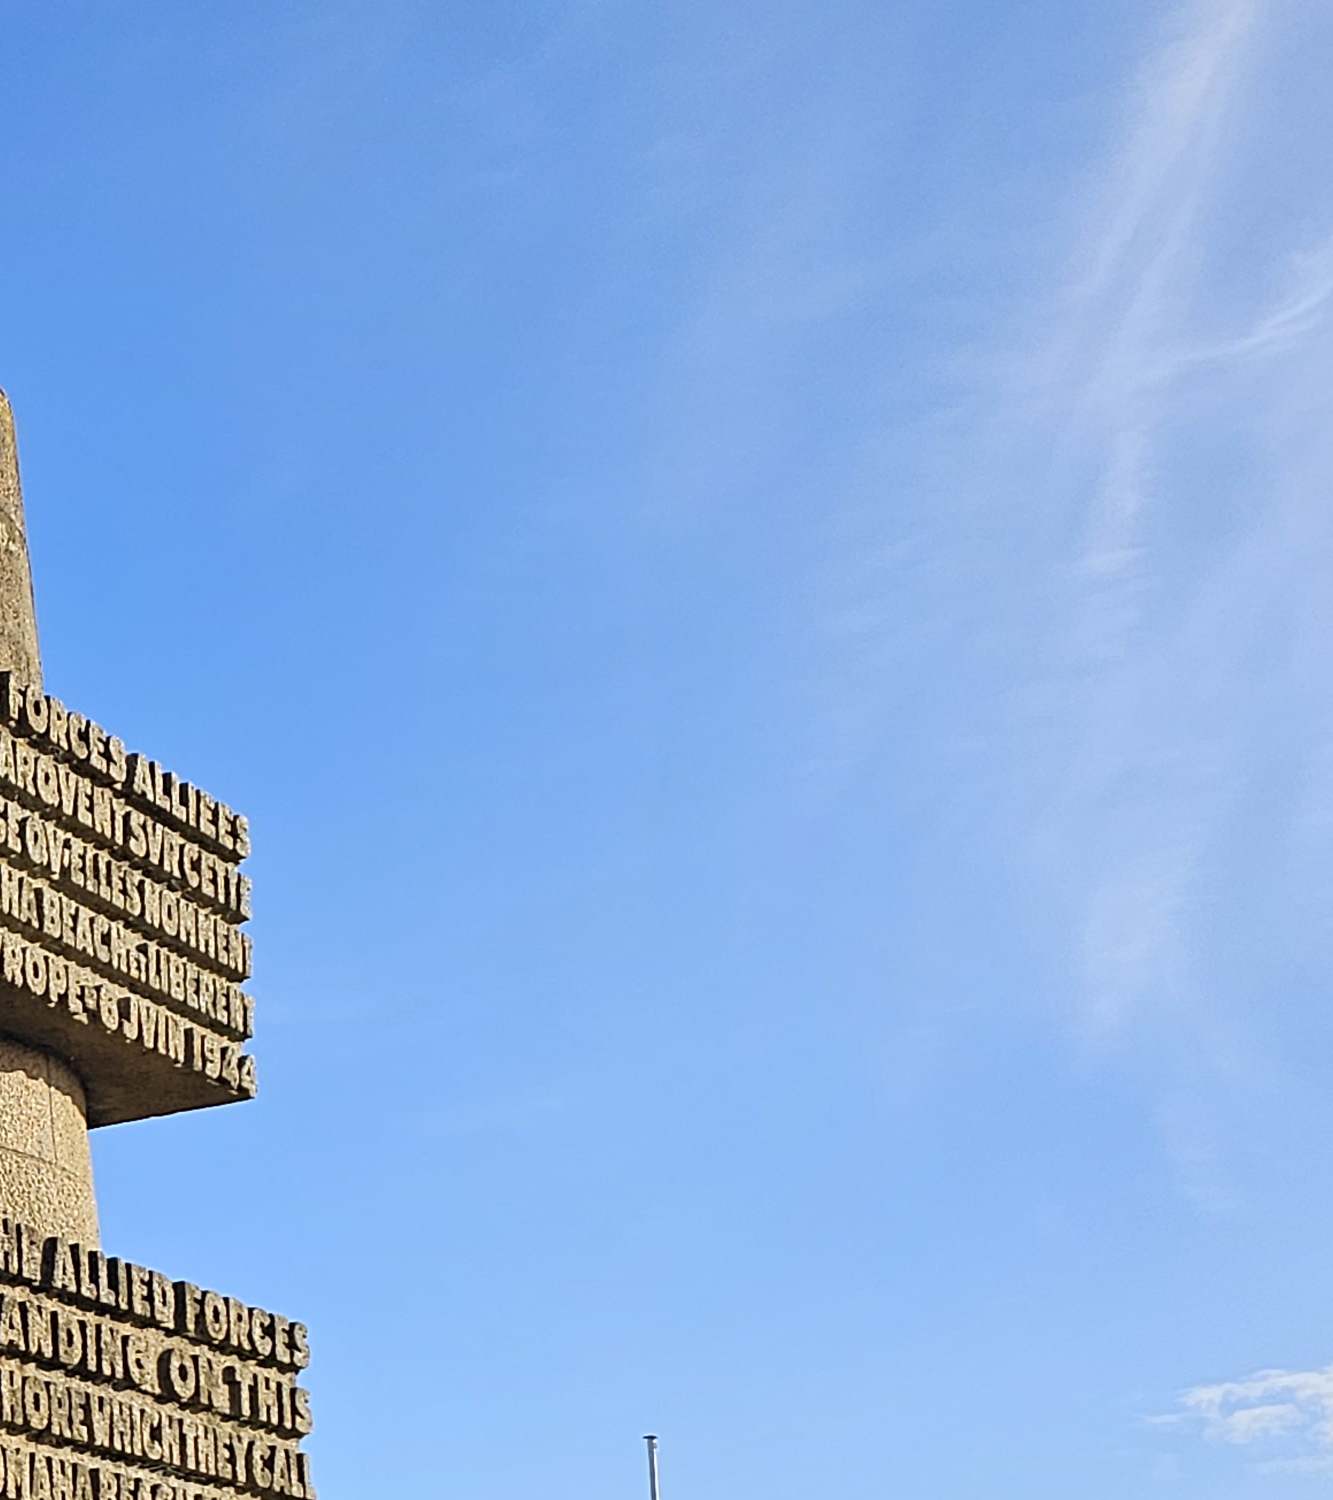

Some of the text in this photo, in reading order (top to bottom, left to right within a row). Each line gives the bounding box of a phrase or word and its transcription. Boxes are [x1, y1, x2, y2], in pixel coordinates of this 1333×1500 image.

[8, 676, 127, 784] FORCES
[133, 753, 251, 858] ALLIEES
[43, 885, 128, 974] BEACH
[192, 1024, 257, 1098] 1944
[54, 1237, 175, 1329] ALLIED
[184, 1284, 310, 1370] FORCES
[169, 1346, 231, 1416] ON
[234, 1363, 313, 1434] THIS
[252, 1438, 316, 1500] CALL
